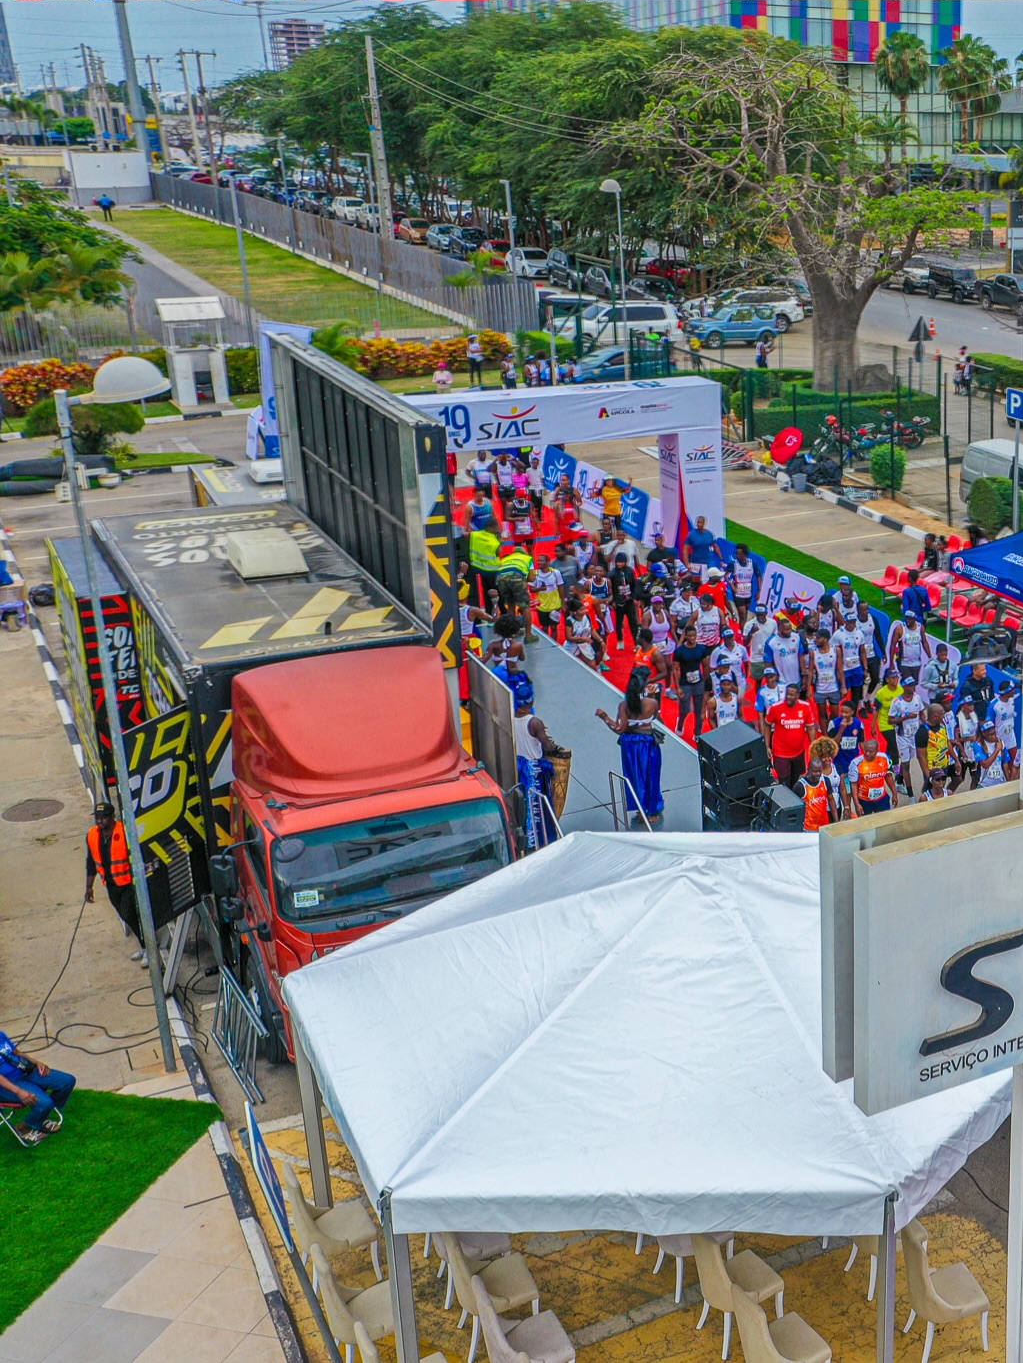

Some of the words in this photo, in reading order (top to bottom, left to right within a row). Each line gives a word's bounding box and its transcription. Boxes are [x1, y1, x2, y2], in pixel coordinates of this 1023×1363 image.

[1011, 393, 1021, 414] P
[439, 404, 471, 448] 19
[476, 417, 540, 441] SIAC
[686, 451, 716, 462] SIAC
[962, 563, 999, 587] ANGOLAUTO
[919, 1048, 989, 1083] SERVIÇO
